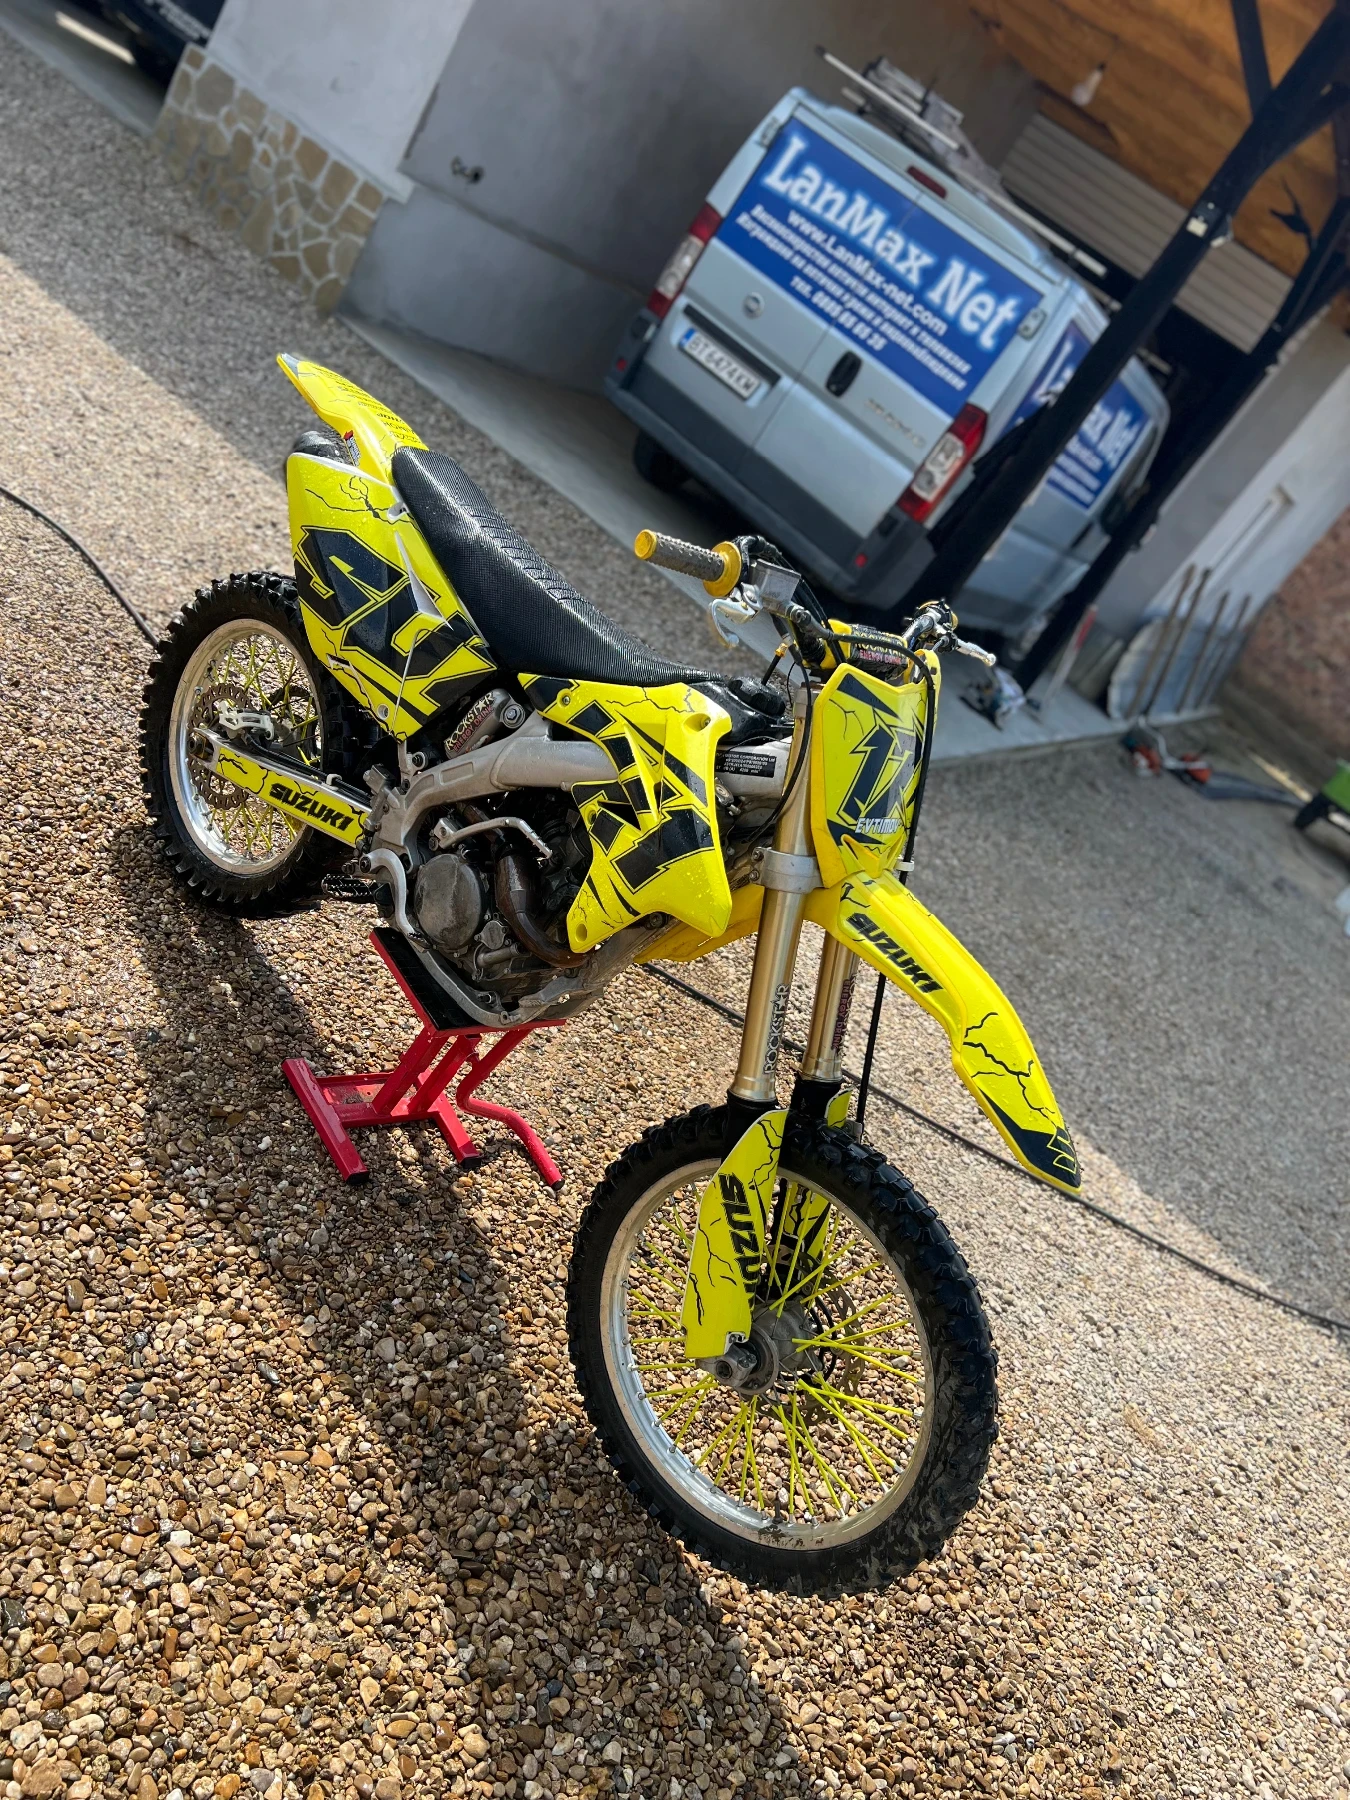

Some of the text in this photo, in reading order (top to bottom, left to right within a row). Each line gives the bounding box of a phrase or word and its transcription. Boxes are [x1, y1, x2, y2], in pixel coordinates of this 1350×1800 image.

[764, 136, 1018, 348] LanMax Net
[787, 209, 948, 337] www.LanMax-net.com
[453, 725, 475, 752] ENERGY
[473, 704, 493, 726] DRINK
[269, 782, 355, 832] SUZUKI
[846, 911, 944, 993] SUZUKI
[832, 979, 850, 1050] ENERGY DRINK
